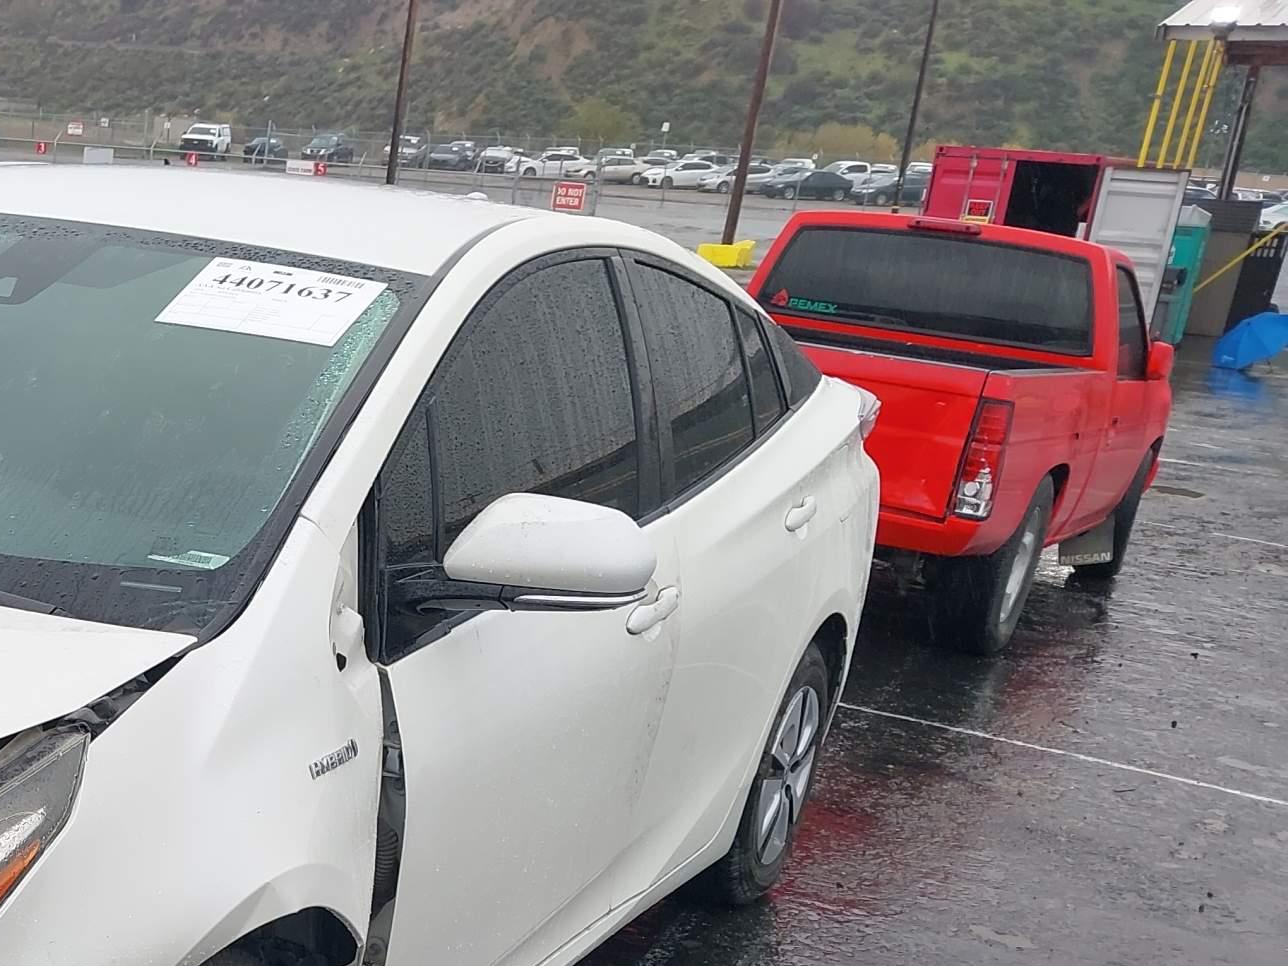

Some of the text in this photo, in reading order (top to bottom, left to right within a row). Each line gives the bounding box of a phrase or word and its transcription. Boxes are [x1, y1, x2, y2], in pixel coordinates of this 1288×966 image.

[317, 162, 326, 176] 5
[568, 188, 584, 197] NOT
[556, 196, 580, 206] ENTER
[212, 273, 353, 303] 44071637
[788, 298, 838, 314] PEMEX
[308, 738, 359, 780] HYBRID
